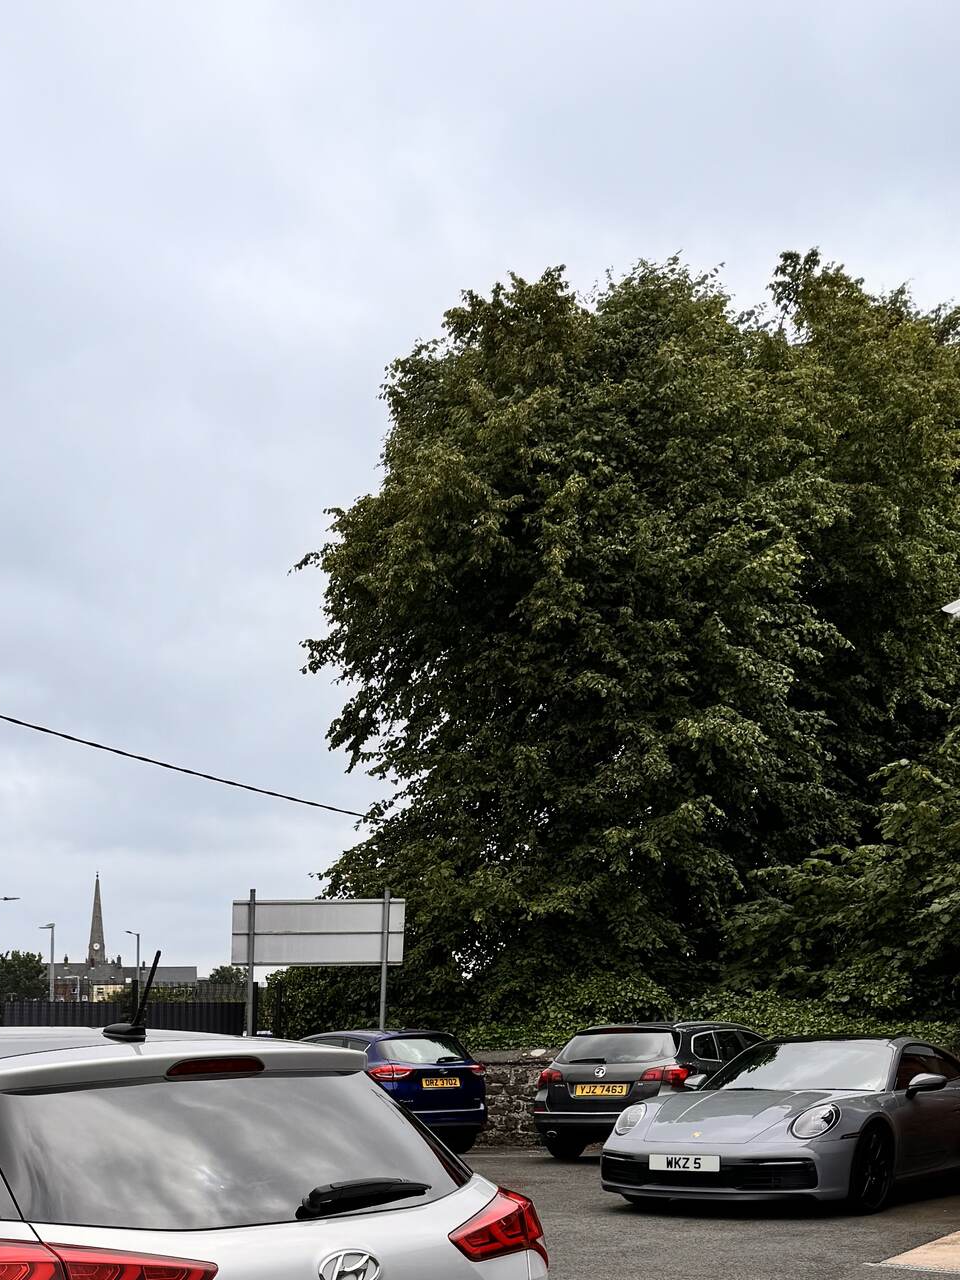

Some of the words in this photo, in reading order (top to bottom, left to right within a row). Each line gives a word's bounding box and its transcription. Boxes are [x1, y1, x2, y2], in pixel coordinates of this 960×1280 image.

[440, 1078, 457, 1086] 3702
[580, 1085, 598, 1095] YJZ
[600, 1085, 624, 1094] 7463
[666, 1157, 690, 1169] WKZ
[693, 1157, 701, 1169] 5
